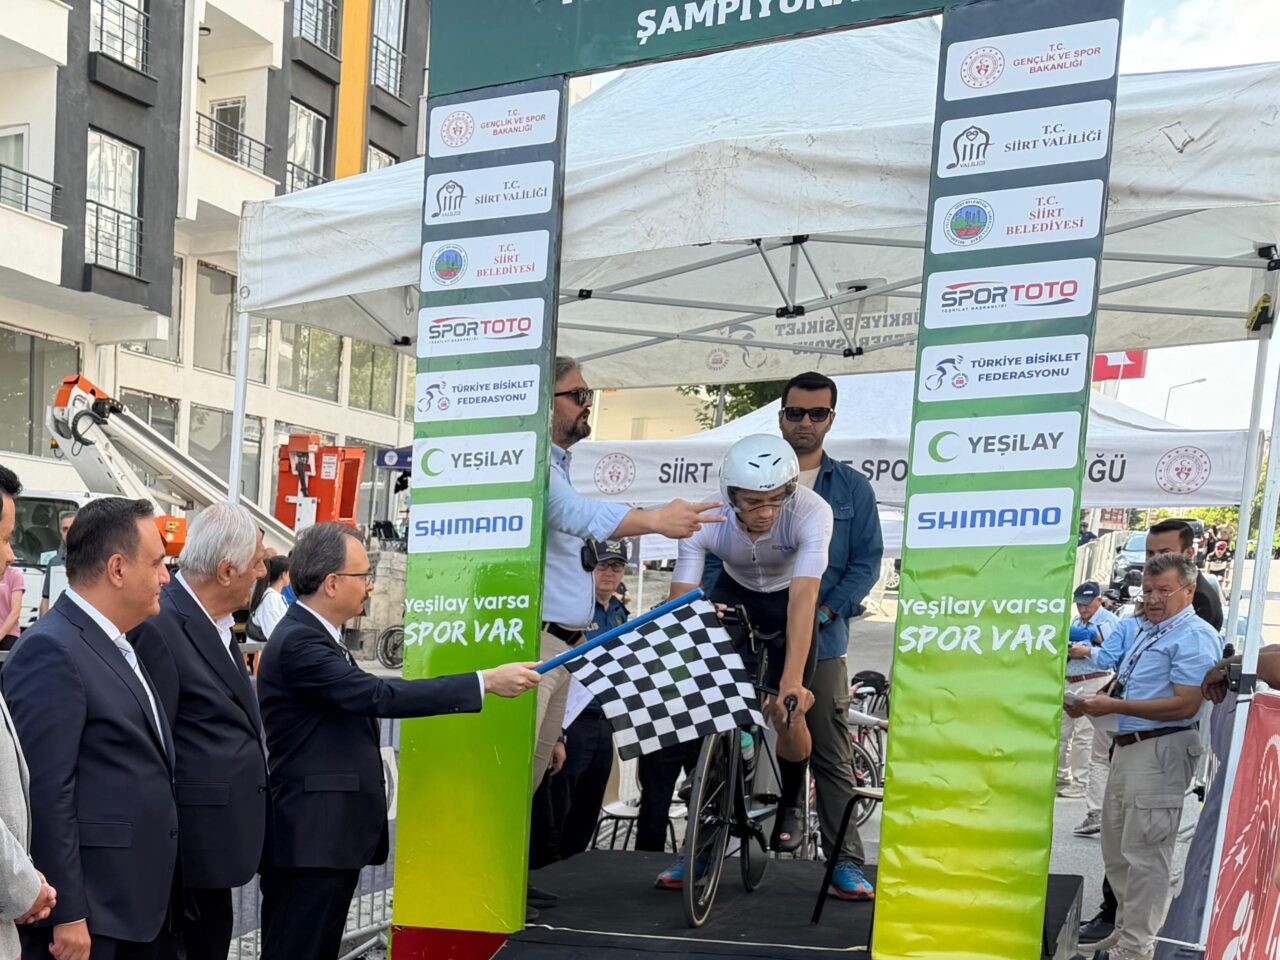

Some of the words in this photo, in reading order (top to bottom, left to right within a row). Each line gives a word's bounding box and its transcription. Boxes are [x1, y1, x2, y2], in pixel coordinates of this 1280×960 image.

[1049, 43, 1066, 52] T.C.
[1013, 53, 1055, 67] GENÇLİK
[1058, 52, 1071, 60] VE
[1073, 47, 1101, 58] SPOR
[1029, 59, 1083, 74] BAKANLIĞI
[514, 117, 524, 125] VE
[526, 114, 546, 123] SPOR
[493, 125, 533, 136] BAKANLIĞI
[1042, 123, 1065, 135] T.C.
[1004, 139, 1039, 153] SİİRT
[1042, 129, 1102, 148] VALİLİĞİ
[503, 180, 520, 189] T.C.
[1036, 196, 1058, 207] T.C.
[1029, 207, 1064, 221] SİİRT
[1006, 217, 1084, 236] BELEDİYESİ
[500, 244, 516, 253] T.C.
[476, 262, 535, 277] BELEDİYESİ
[970, 355, 1022, 369] TÜRKİYE
[1025, 352, 1081, 365] BİSİKLET
[978, 368, 1070, 382] FEDERASYONU
[452, 382, 490, 393] TÜRKİYE
[493, 380, 535, 390] BİSİKLET
[457, 393, 527, 405] FEDERASYONU
[658, 457, 713, 484] SİİRT
[861, 459, 909, 482] SPO
[415, 515, 523, 536] SHIMANO
[917, 506, 1061, 530] SHIMANO
[405, 595, 469, 615] Yeşilay
[474, 594, 529, 610] varsa
[899, 596, 985, 619] Yeşilay
[992, 597, 1065, 614] varsa
[404, 620, 468, 646] SPOR
[474, 618, 525, 646] VAR
[898, 625, 982, 655] SPOR
[991, 623, 1058, 655] VAR
